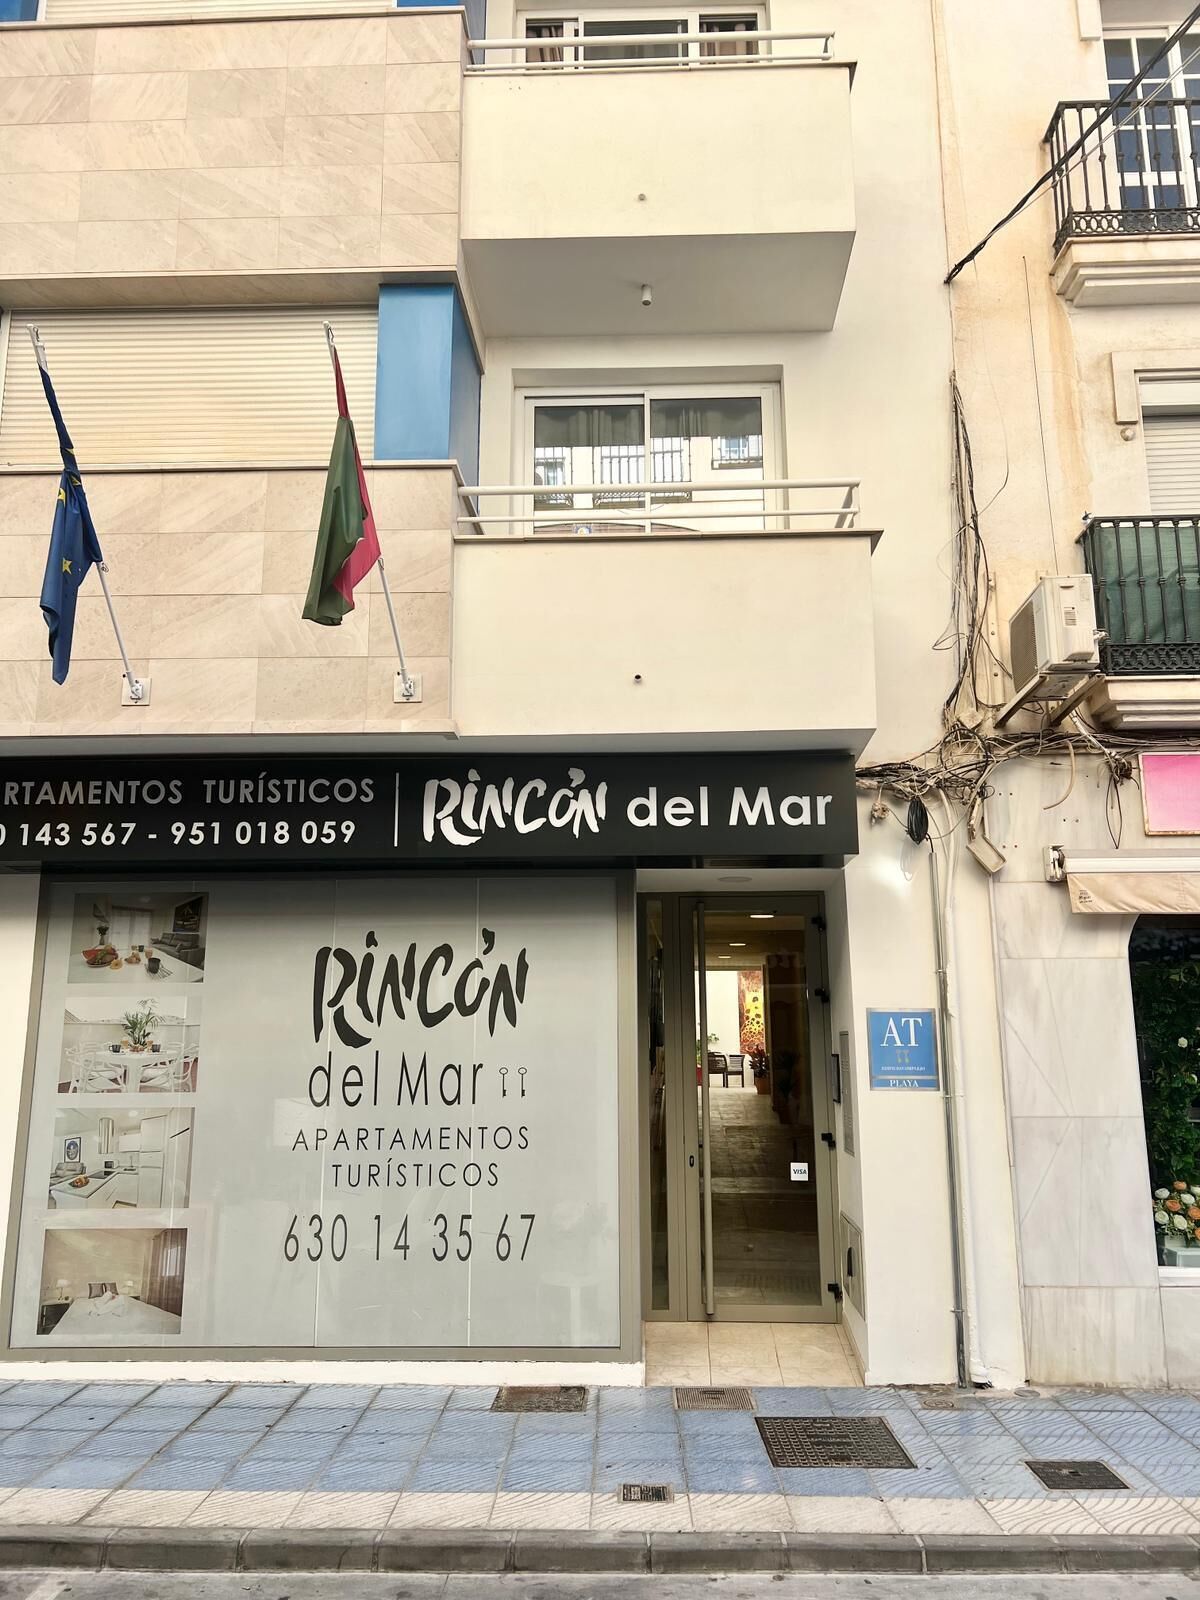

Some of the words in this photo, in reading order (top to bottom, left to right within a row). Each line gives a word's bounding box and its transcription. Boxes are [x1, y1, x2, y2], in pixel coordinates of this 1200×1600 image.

[4, 780, 183, 806] RTAMENTOS
[203, 772, 374, 804] TURÍSTICOS
[626, 786, 709, 827] del
[728, 786, 833, 826] Mar
[20, 823, 71, 846] 143
[81, 822, 136, 846] 567
[171, 821, 220, 845] 951
[235, 821, 290, 845] 018
[301, 820, 356, 844] 059
[880, 1016, 923, 1047] AT
[308, 1050, 380, 1107] del
[397, 1051, 484, 1106] Mar
[889, 1079, 919, 1087] PLAYA
[291, 1125, 529, 1151] APARTAMENTOS
[331, 1158, 498, 1187] TURÍSTICOS
[284, 1213, 348, 1262] 630
[374, 1214, 410, 1261] 14
[432, 1213, 473, 1262] 35
[495, 1213, 536, 1262] 67
